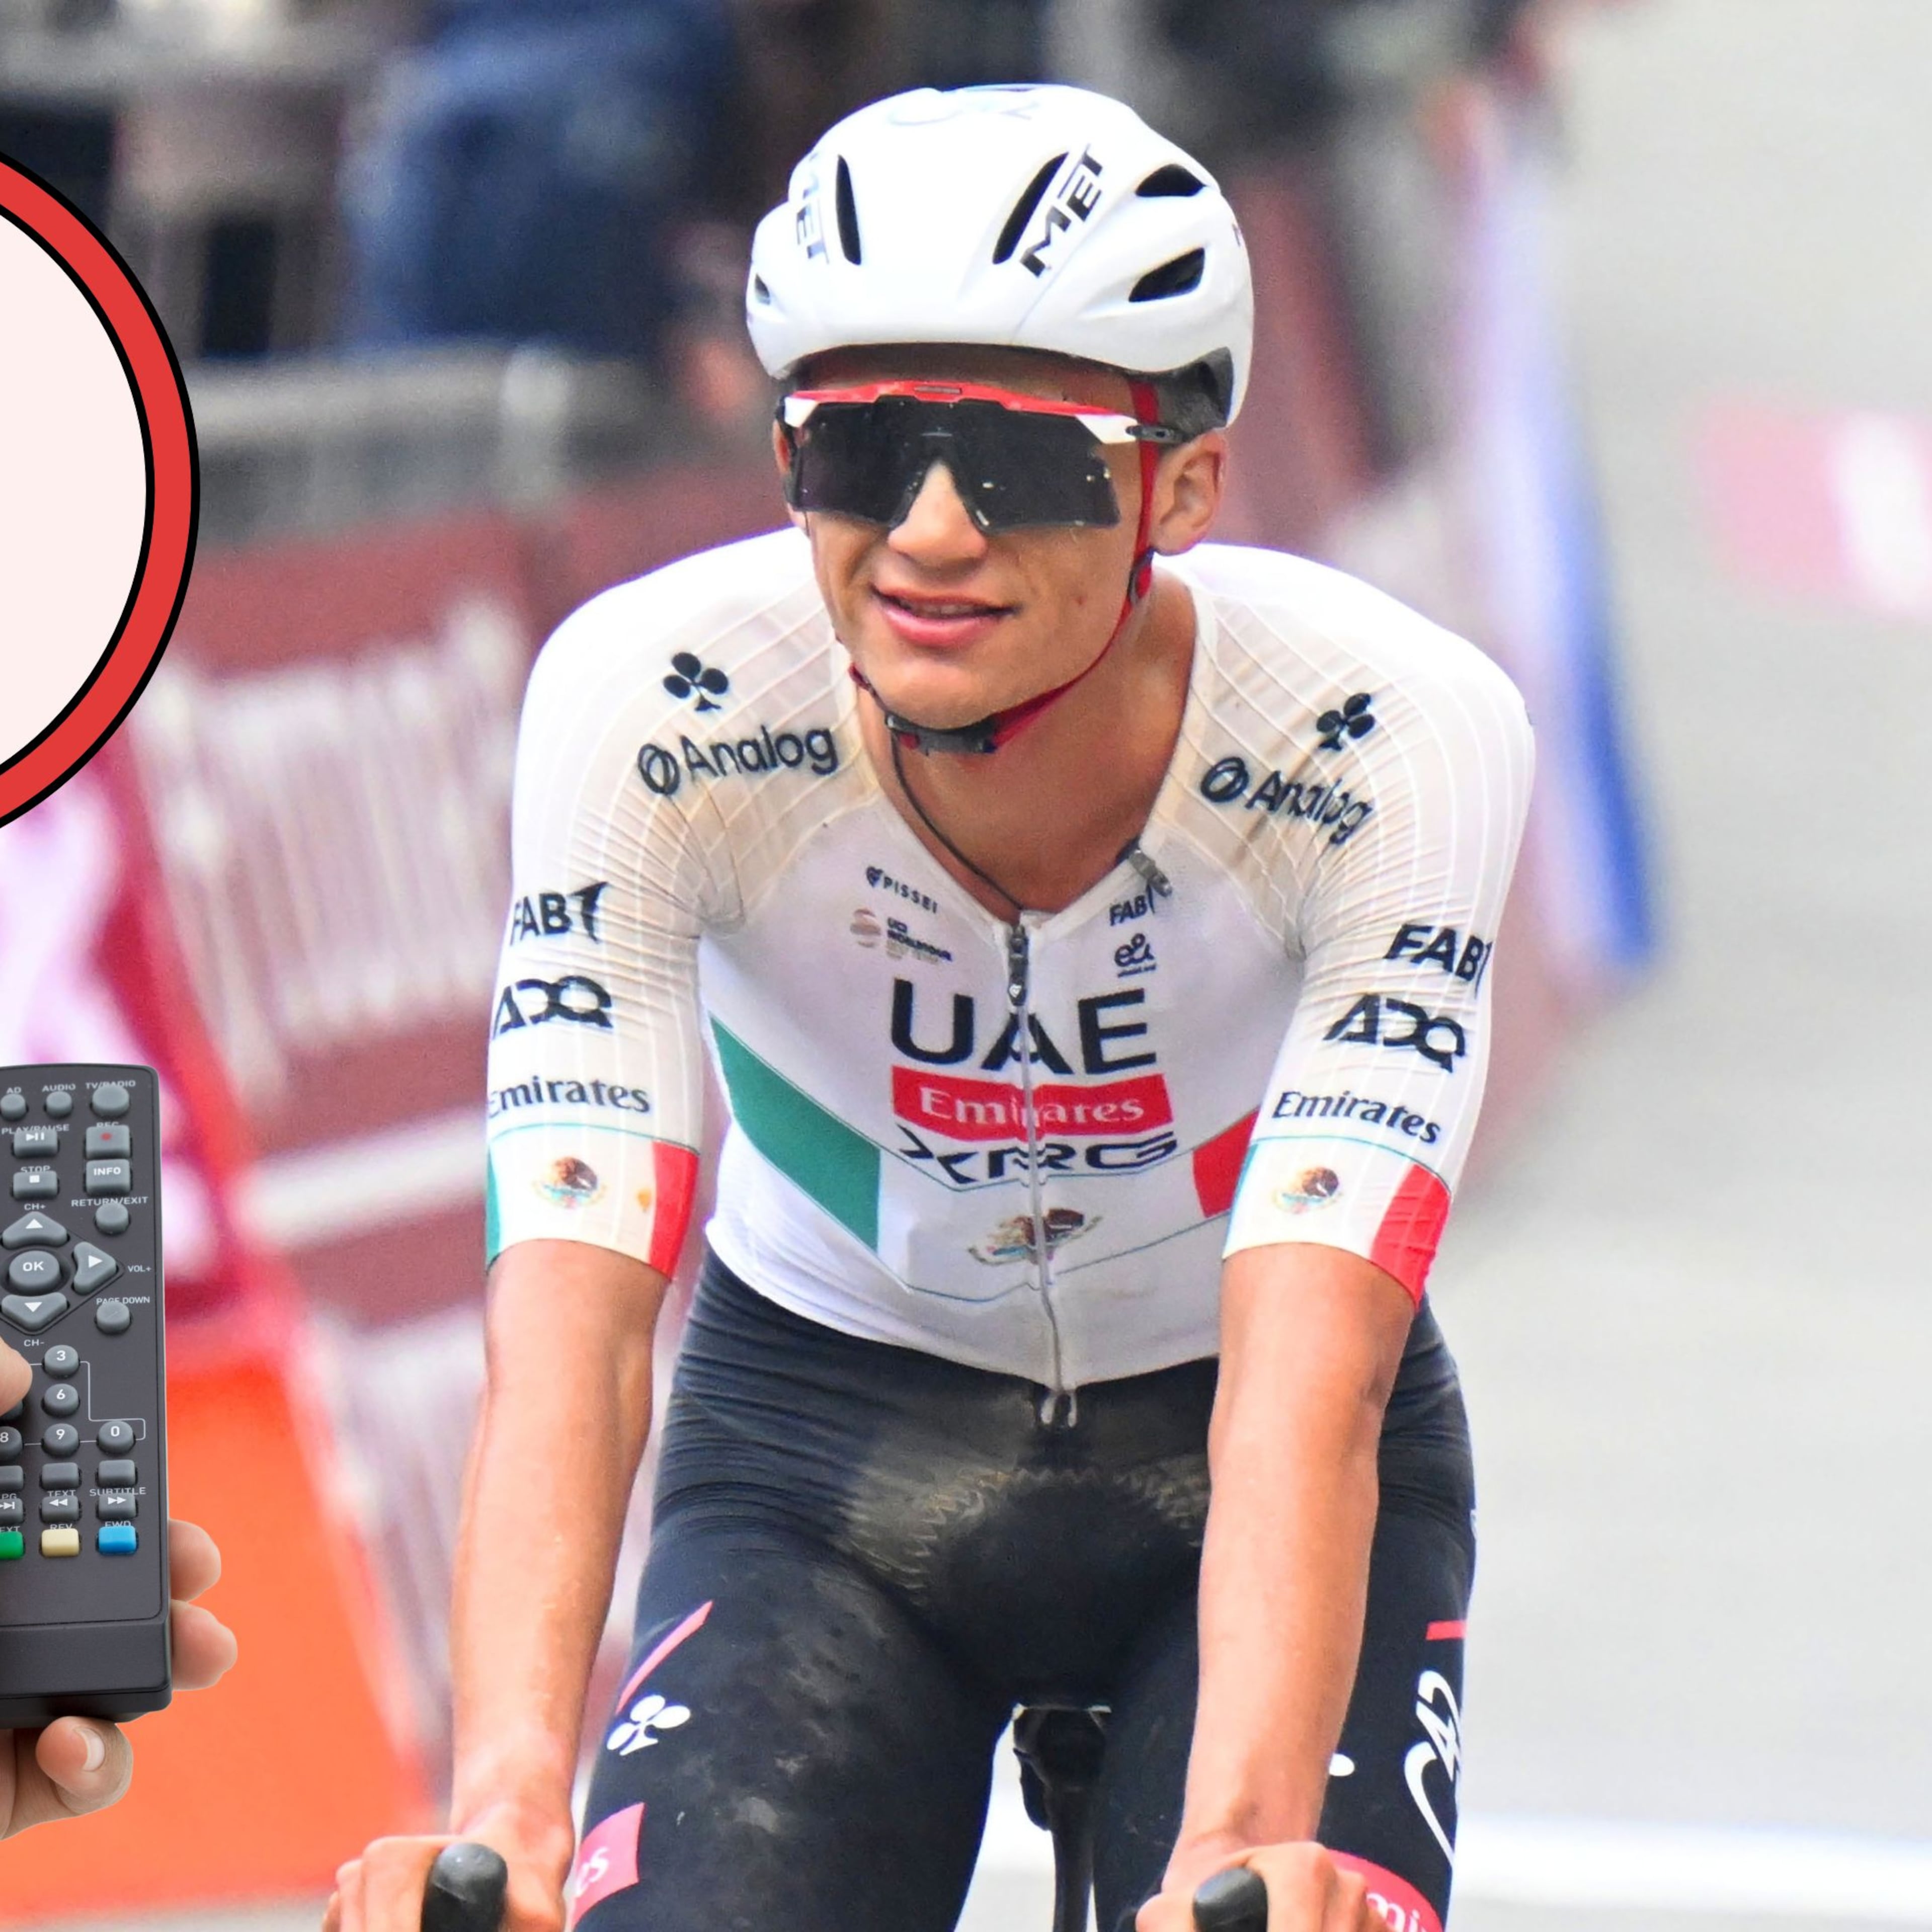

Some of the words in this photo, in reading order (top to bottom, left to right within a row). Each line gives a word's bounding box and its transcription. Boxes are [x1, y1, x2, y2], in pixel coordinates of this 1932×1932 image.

[1020, 143, 1103, 279] MET
[679, 725, 839, 781] Analog
[1246, 770, 1373, 844] Analog
[883, 876, 937, 914] PISSEI
[891, 978, 1156, 1075] UAE
[1323, 994, 1465, 1073] ADQ
[42, 1083, 76, 1092] AUDIO
[85, 1080, 136, 1089] TV/RADIO
[1271, 1090, 1441, 1144] Emirates
[2, 1123, 69, 1135] PLAY/PAUSE
[896, 1123, 1177, 1183] XRG
[21, 1165, 50, 1173] STOP
[94, 1167, 121, 1175] INFO
[71, 1196, 148, 1206] RETURN/EXIT
[23, 1261, 44, 1271] OK
[122, 1296, 150, 1304] DOWN
[24, 1339, 45, 1347] CH-
[56, 1350, 66, 1361] 3
[56, 1389, 65, 1400] 6
[0, 1431, 9, 1442] 8
[56, 1429, 65, 1440] 9
[111, 1426, 120, 1436] 0
[90, 1487, 146, 1496] SUBTITLE
